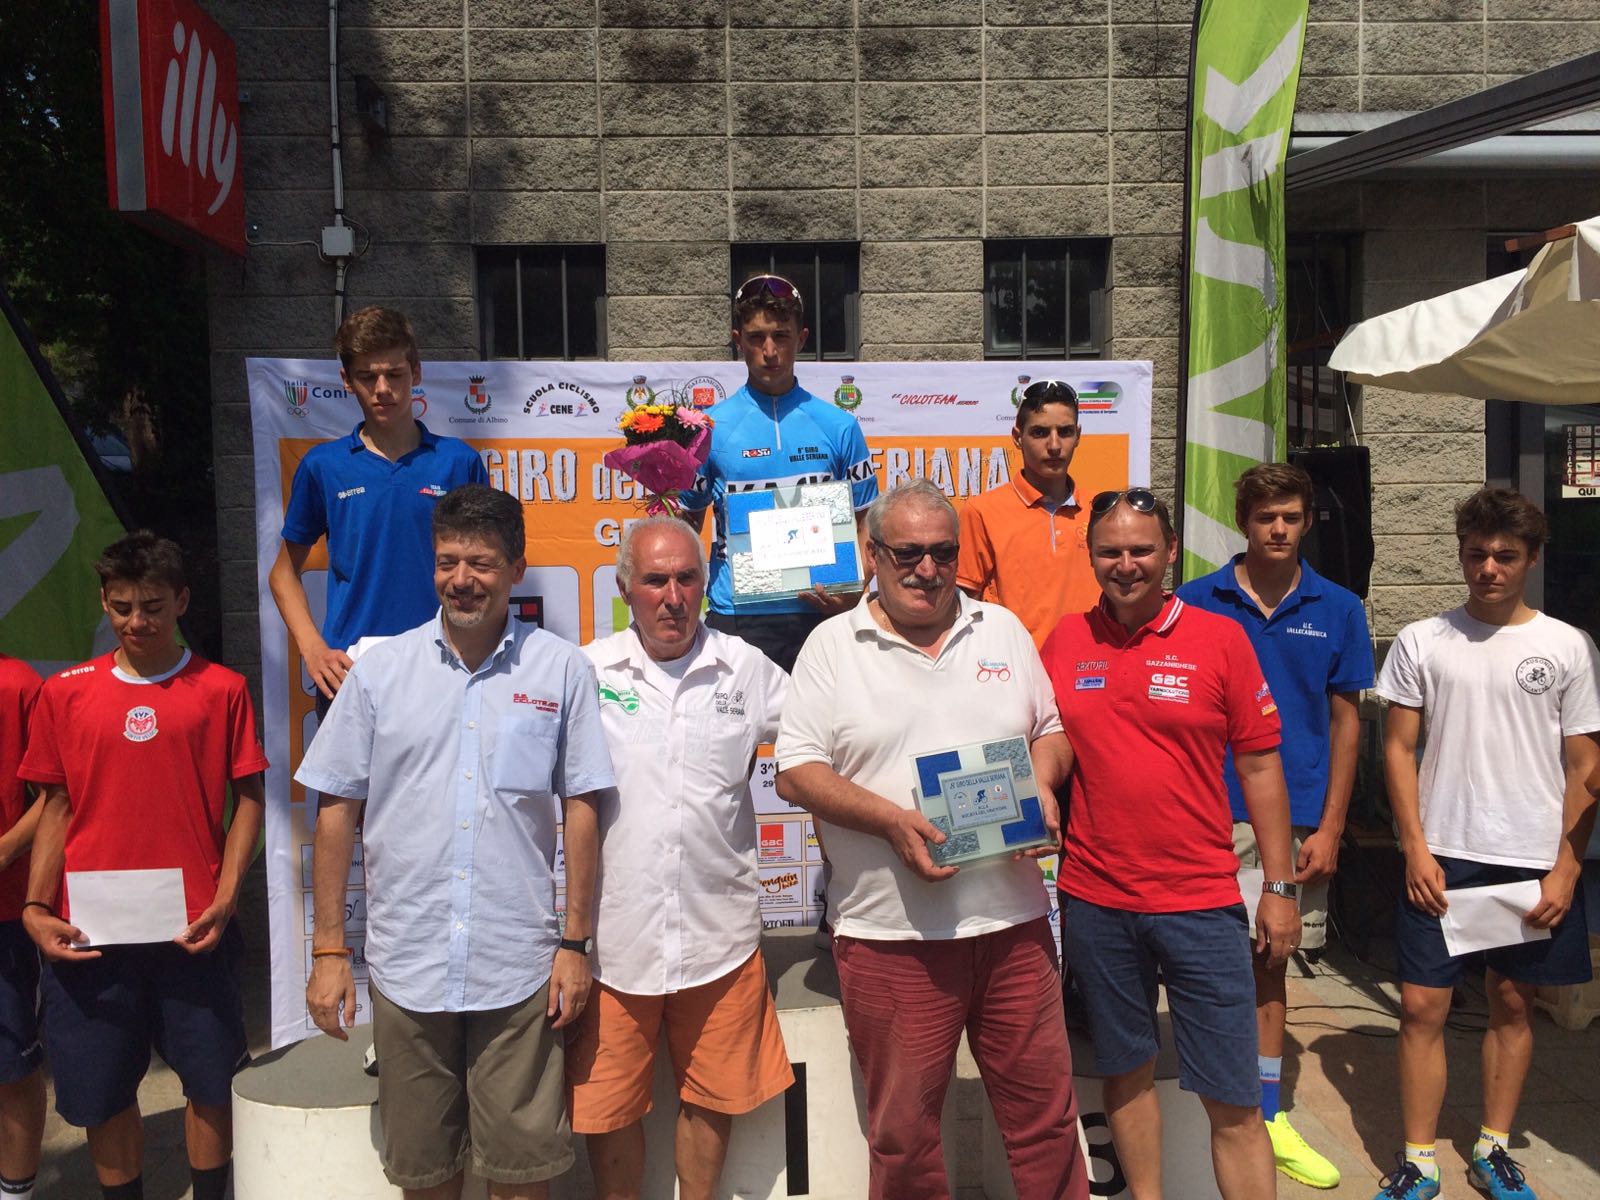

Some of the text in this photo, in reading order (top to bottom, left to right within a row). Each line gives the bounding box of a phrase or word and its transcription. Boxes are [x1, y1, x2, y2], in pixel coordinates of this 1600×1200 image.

[161, 20, 237, 216] illy
[312, 386, 348, 399] Coni
[523, 382, 600, 414] SCUOLA CICLISMO
[899, 394, 958, 405] CICLOTEAM
[550, 404, 573, 414] CENE
[483, 448, 577, 502] GIRO
[1578, 488, 1597, 496] QUI
[1151, 673, 1189, 687] GBC
